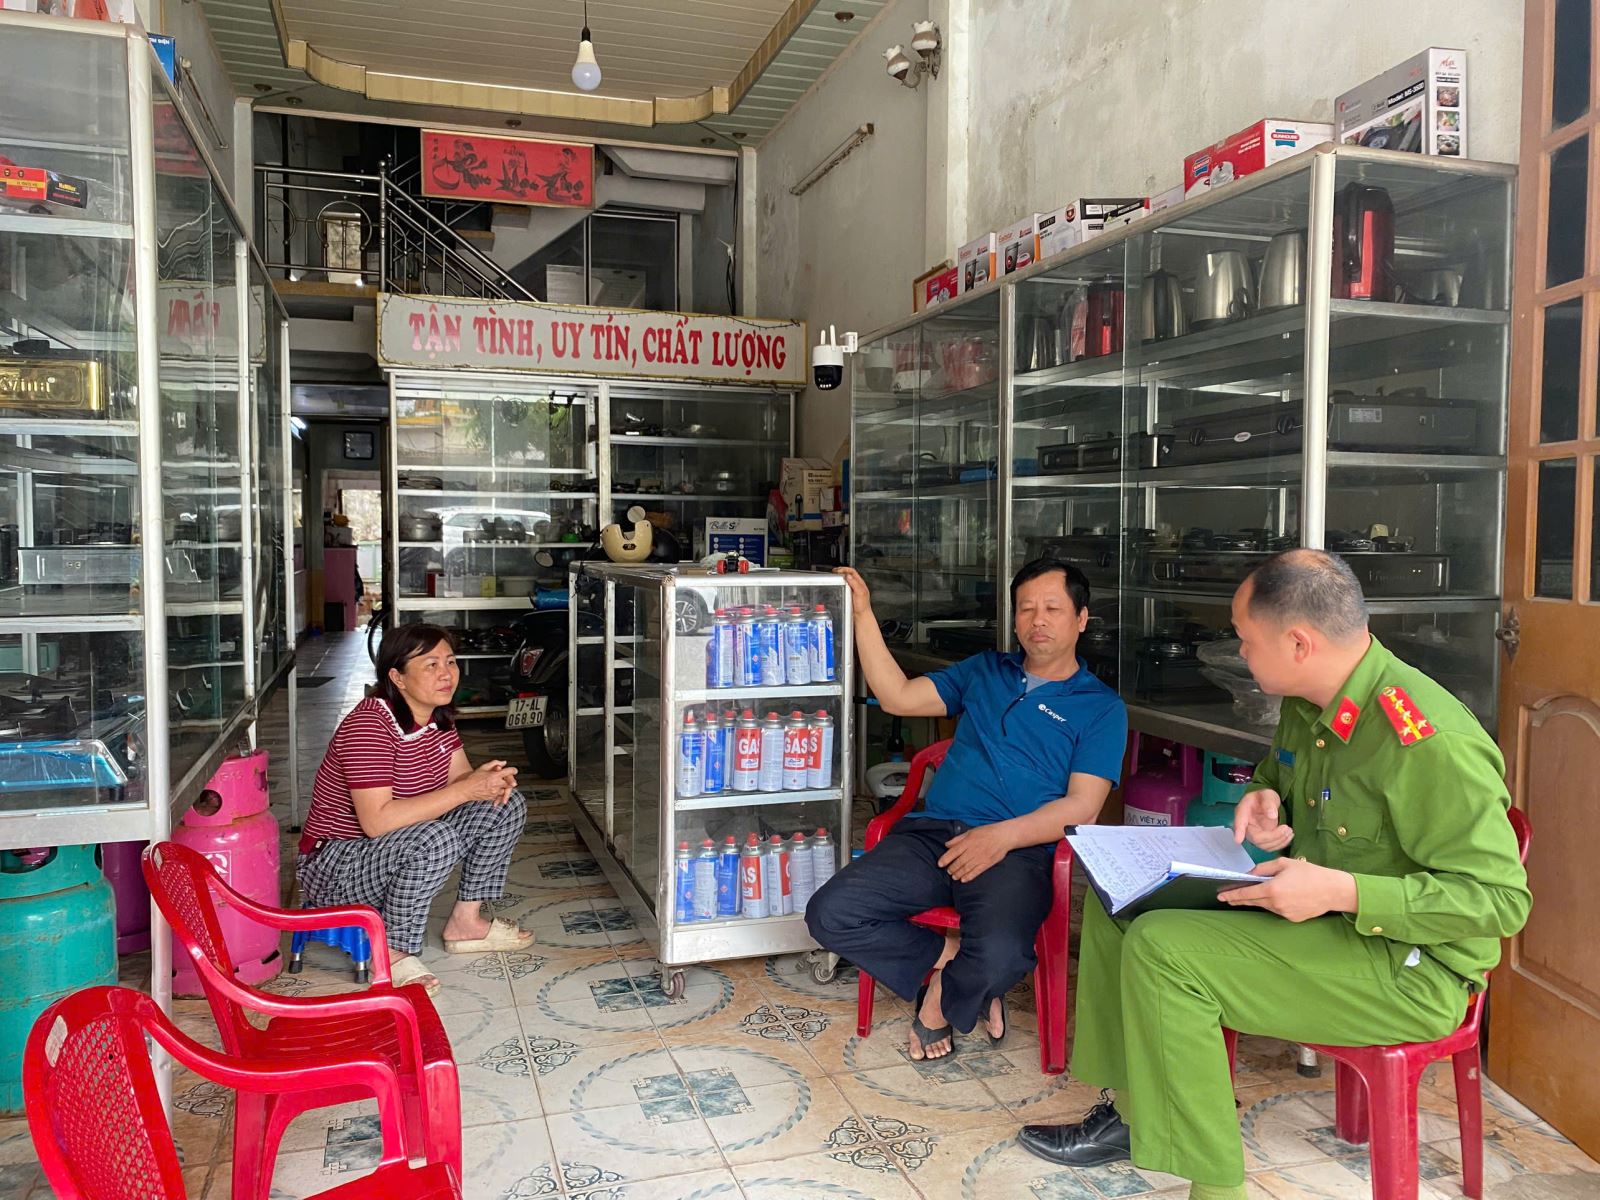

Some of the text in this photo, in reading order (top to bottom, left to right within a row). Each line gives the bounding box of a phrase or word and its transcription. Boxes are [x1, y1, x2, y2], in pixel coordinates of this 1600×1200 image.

[408, 303, 787, 376] TẬN TÌNH, UY TÍN, CHẤT LƯỢNG
[515, 698, 541, 713] 17-AL
[508, 711, 543, 727] 068.90
[1044, 708, 1067, 723] Casper
[785, 736, 808, 754] GAS
